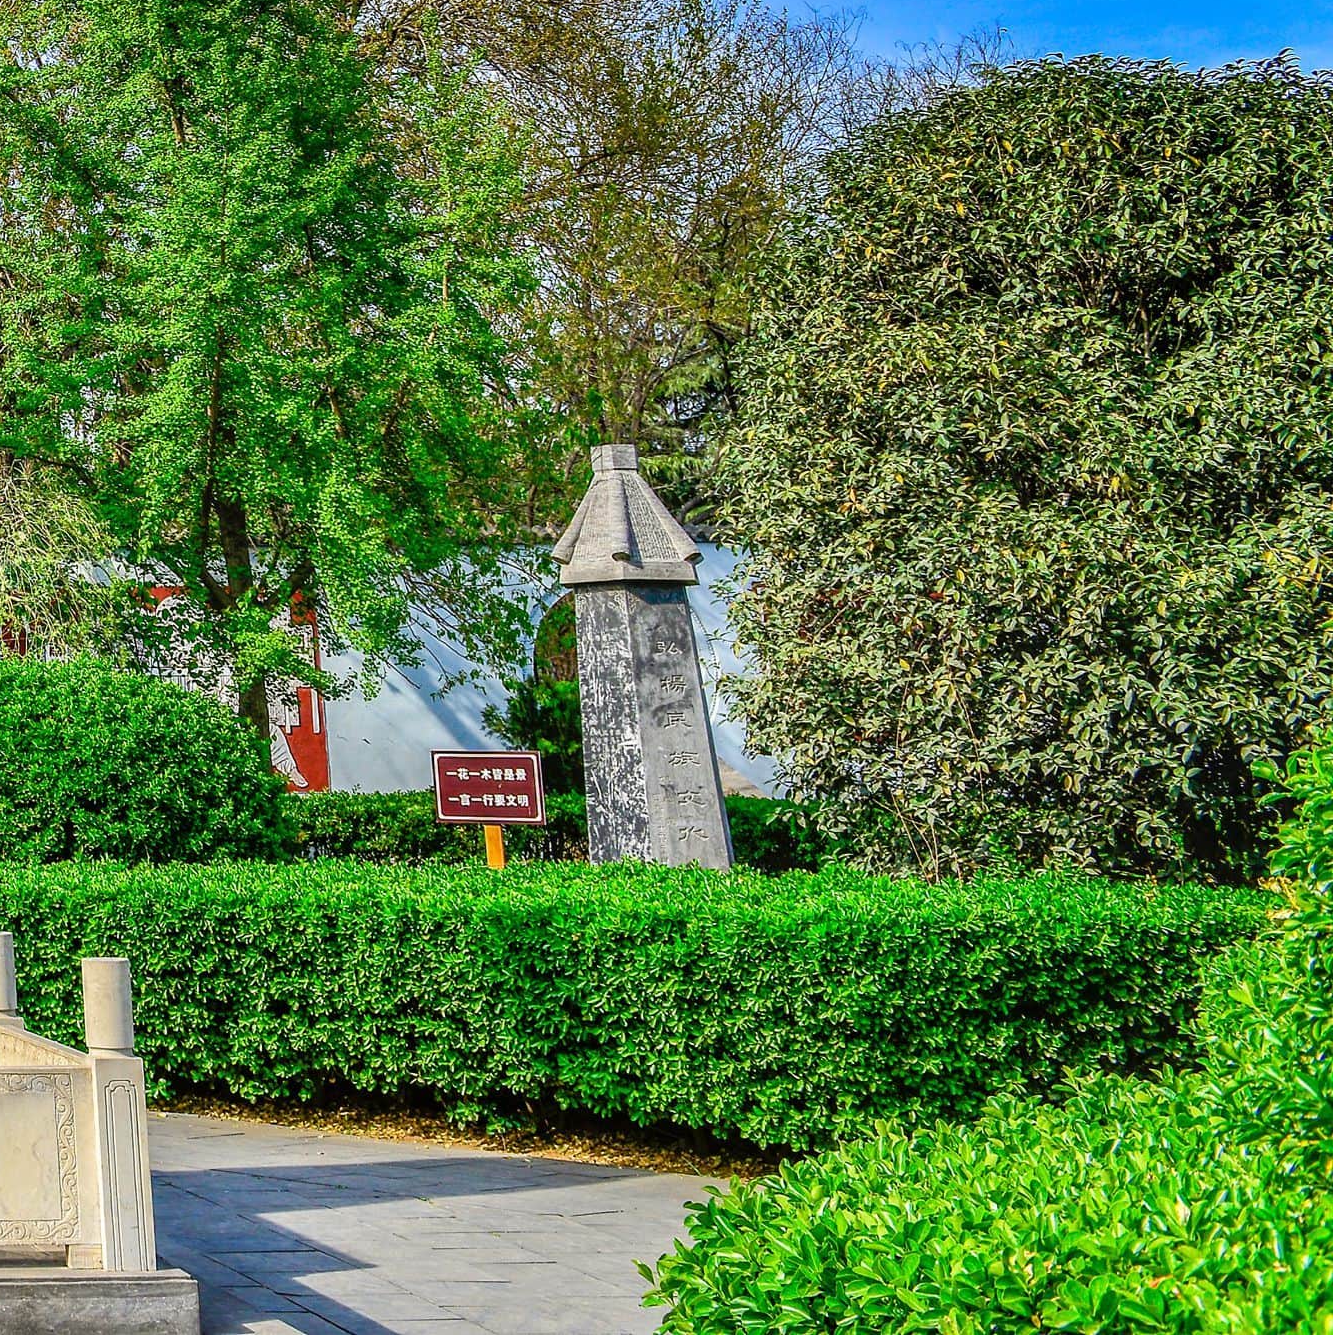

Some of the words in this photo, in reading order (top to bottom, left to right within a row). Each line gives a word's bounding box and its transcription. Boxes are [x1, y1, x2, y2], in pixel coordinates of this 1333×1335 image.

[445, 767, 527, 781] 一花一木皆是景
[448, 793, 530, 807] 一言一行要文明
